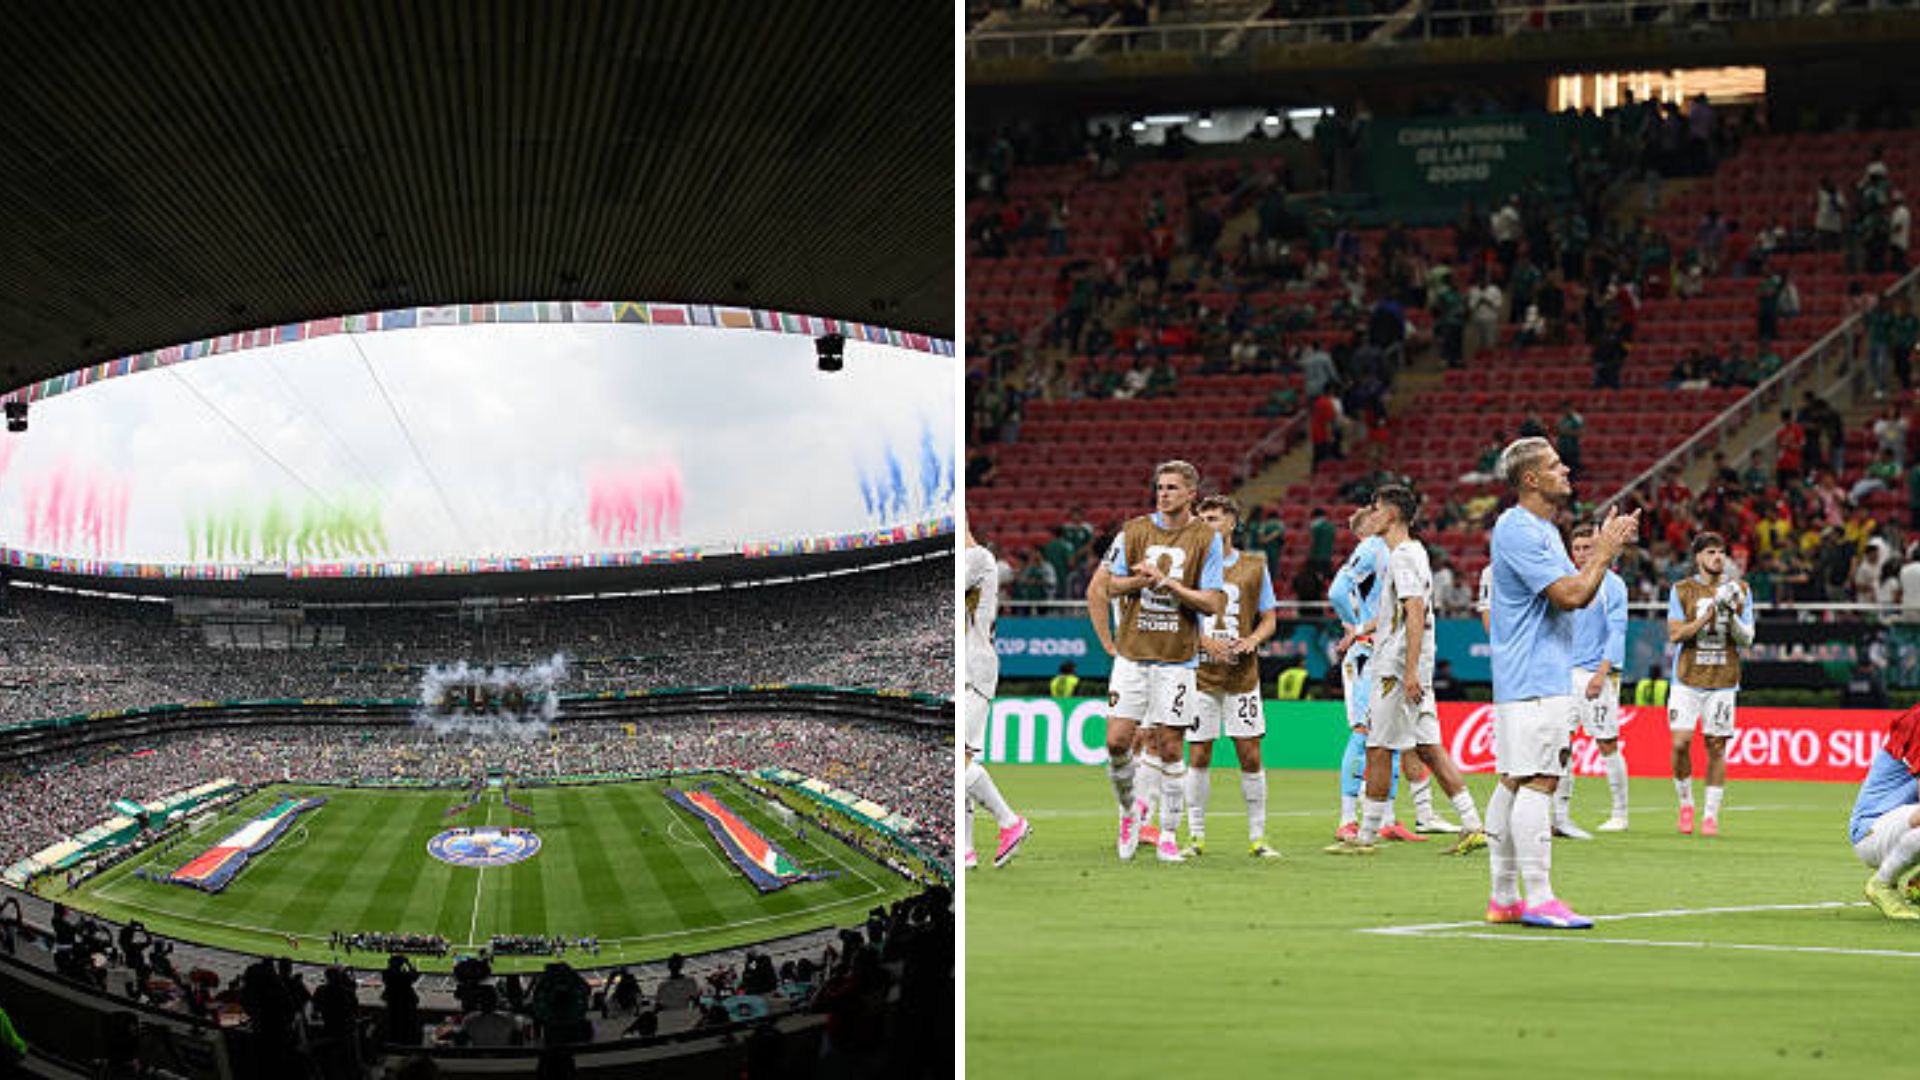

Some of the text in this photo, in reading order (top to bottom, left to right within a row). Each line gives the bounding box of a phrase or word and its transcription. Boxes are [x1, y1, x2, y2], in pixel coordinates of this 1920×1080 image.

[1397, 123, 1526, 145] COPA MUNDIAL
[1416, 144, 1505, 164] DE LA FIFA
[1427, 163, 1490, 182] 2026
[995, 638, 1087, 656] CUP 2026
[1173, 685, 1187, 708] 2
[1238, 696, 1258, 719] 26
[1724, 727, 1820, 767] zero
